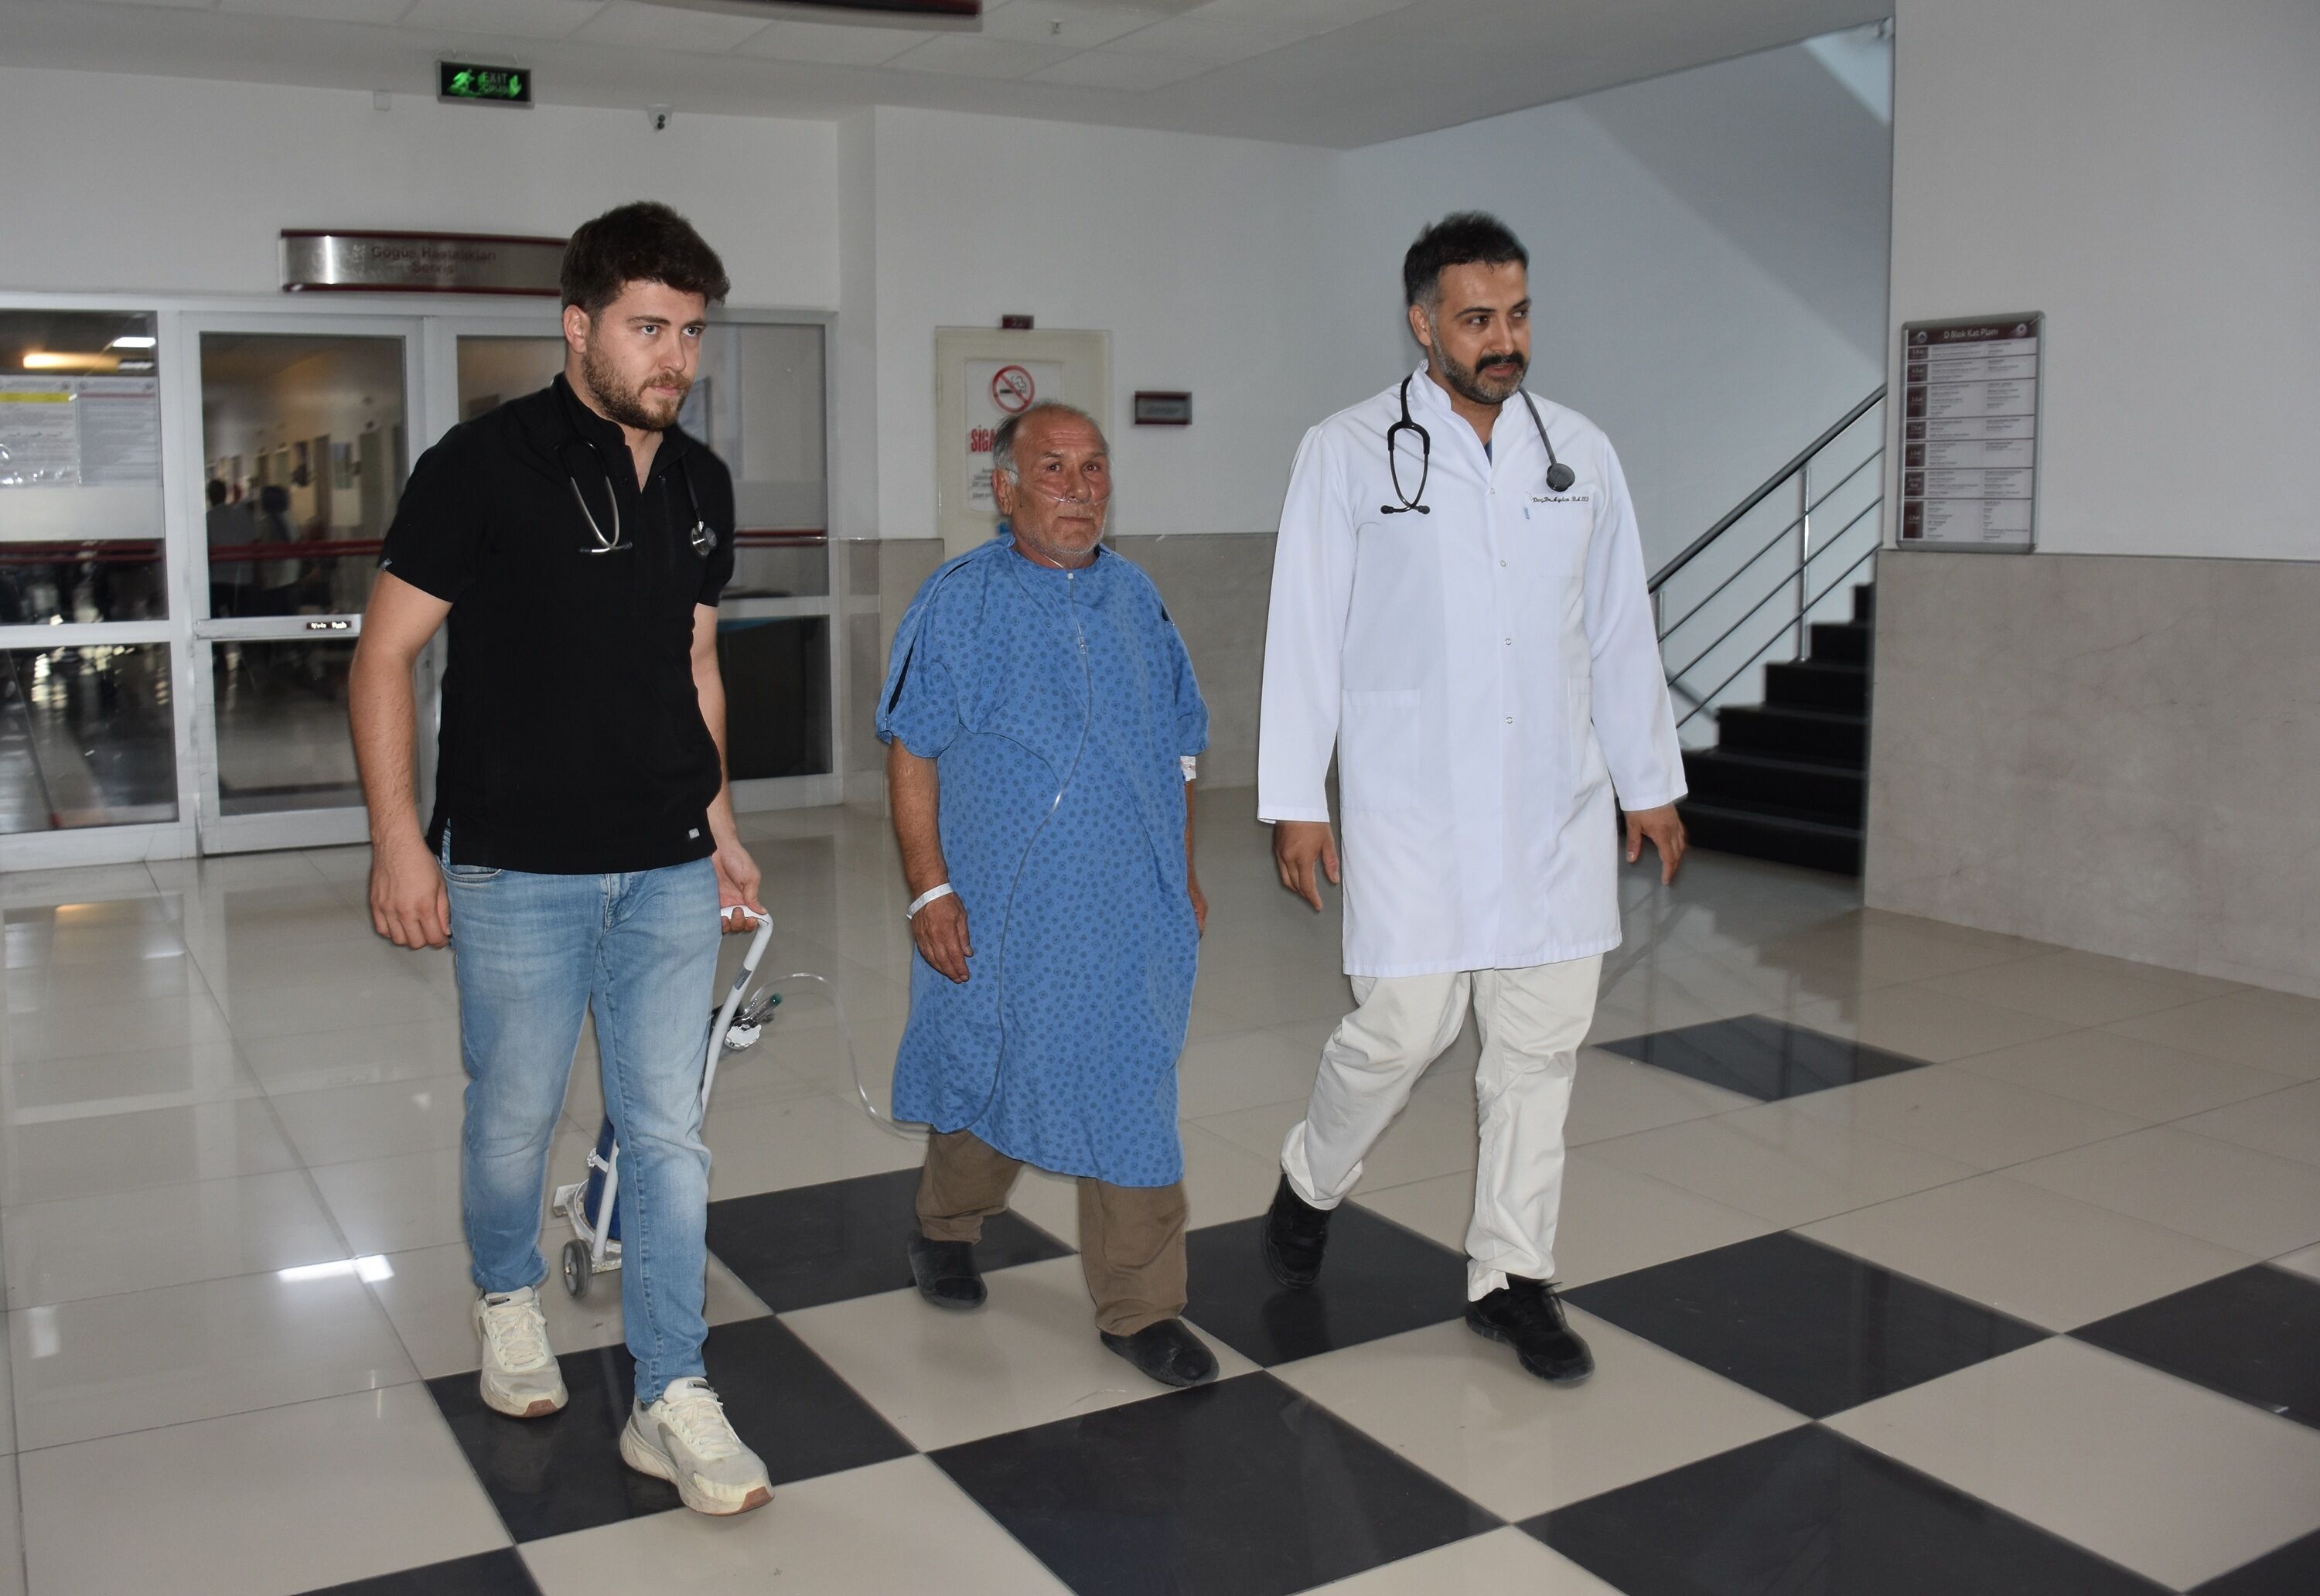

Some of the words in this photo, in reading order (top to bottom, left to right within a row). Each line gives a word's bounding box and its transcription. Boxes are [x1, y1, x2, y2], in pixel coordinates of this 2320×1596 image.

[482, 71, 508, 84] EXIT
[1950, 329, 1966, 338] Blok
[1967, 328, 1980, 337] Kat
[971, 425, 995, 452] SİGA
